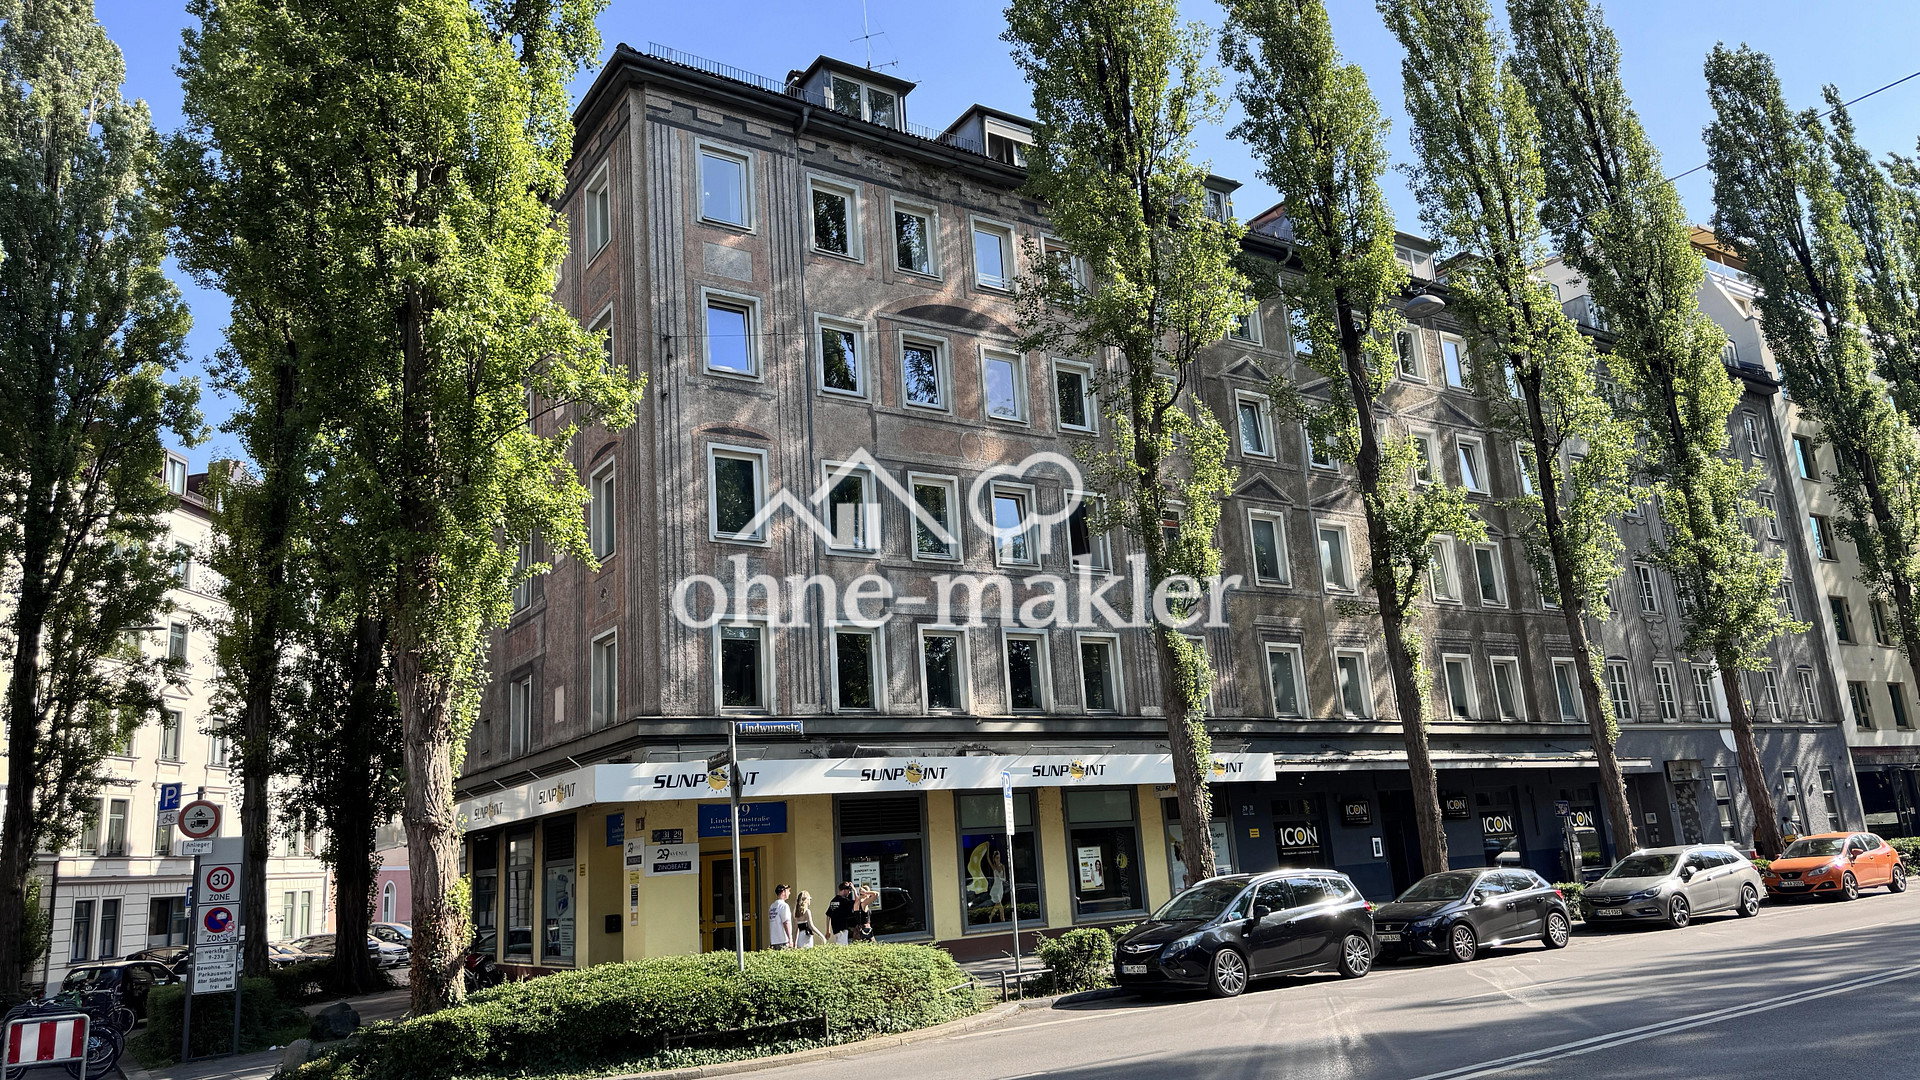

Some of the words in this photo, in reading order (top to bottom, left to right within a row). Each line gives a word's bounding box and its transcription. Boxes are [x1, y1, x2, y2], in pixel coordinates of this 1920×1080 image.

[738, 722, 800, 734] Lindwurmstr.
[164, 786, 177, 807] P
[1345, 803, 1367, 816] ICON
[1447, 799, 1466, 811] ICON
[1482, 815, 1513, 834] ICON
[1566, 810, 1594, 828] ICON
[1279, 826, 1319, 846] ICON
[656, 848, 670, 860] 29
[212, 873, 229, 886] 30
[208, 893, 231, 901] ZONE
[206, 934, 225, 942] ZON
